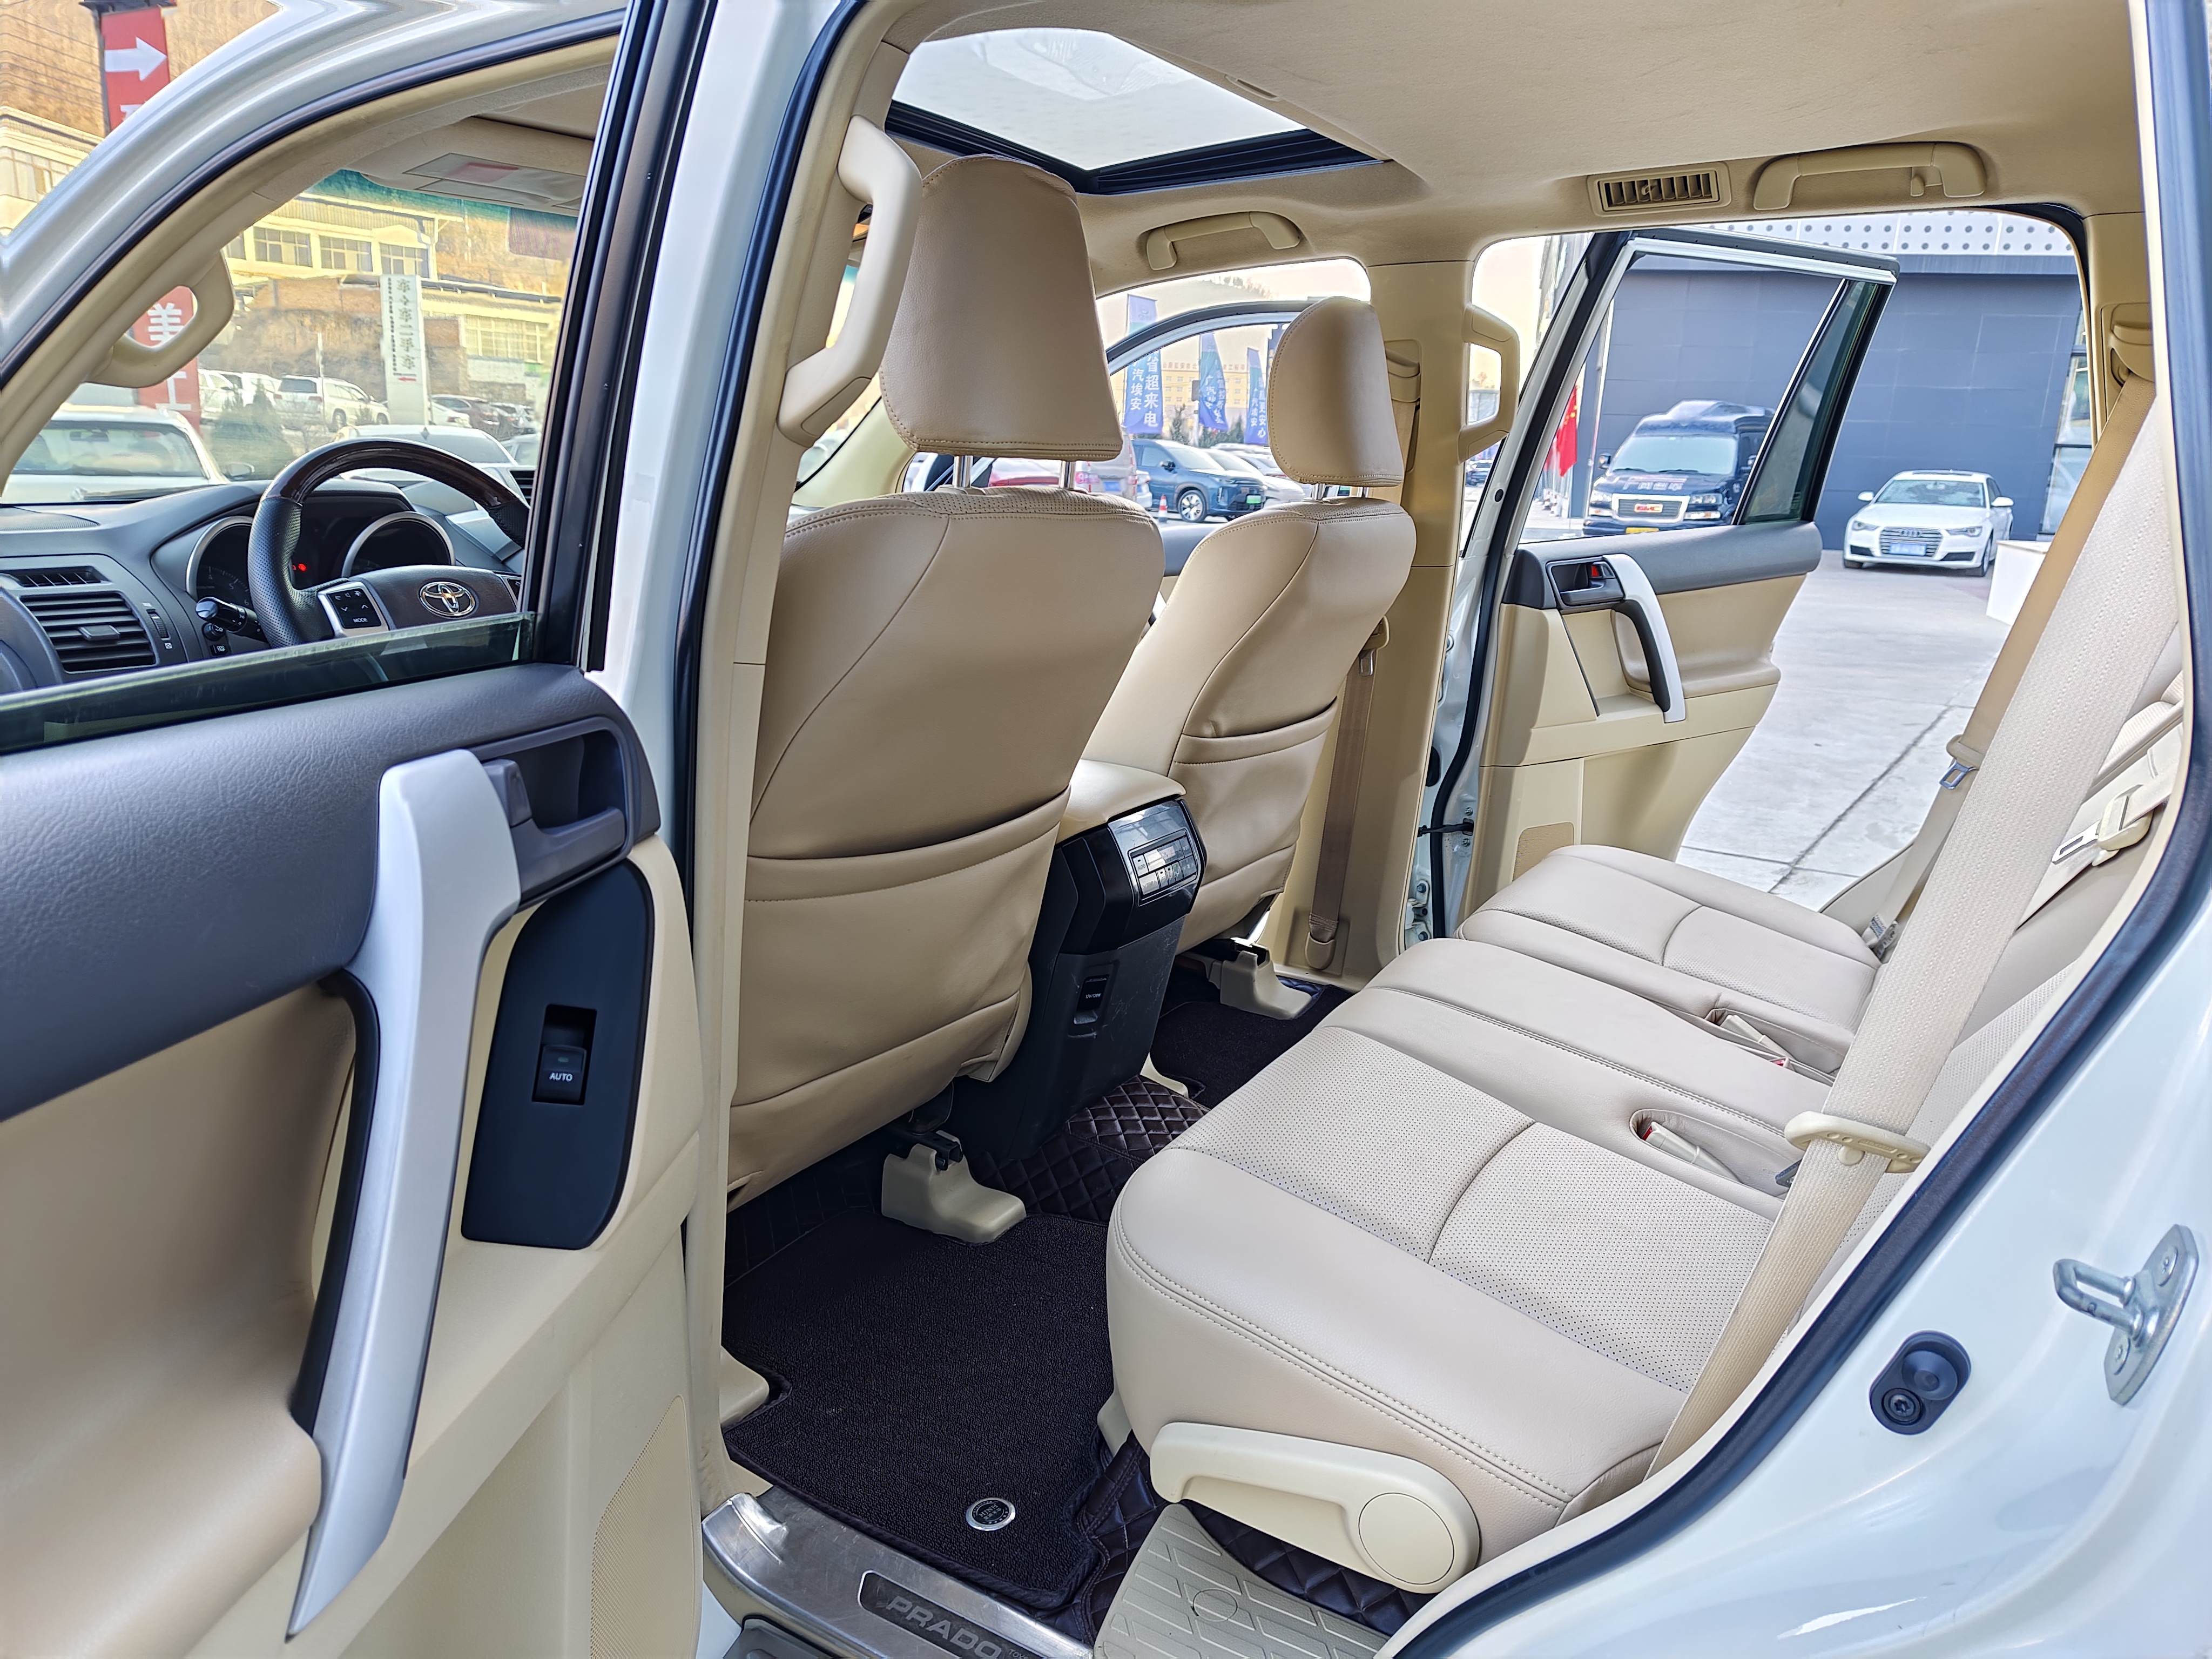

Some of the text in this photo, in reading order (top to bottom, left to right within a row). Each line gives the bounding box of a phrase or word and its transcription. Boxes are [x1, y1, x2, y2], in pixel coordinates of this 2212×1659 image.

[1130, 361, 1144, 411] 汽埃安
[1143, 350, 1160, 427] 省超来电
[549, 1072, 573, 1082] AUTO
[885, 1596, 1002, 1659] PRADO
